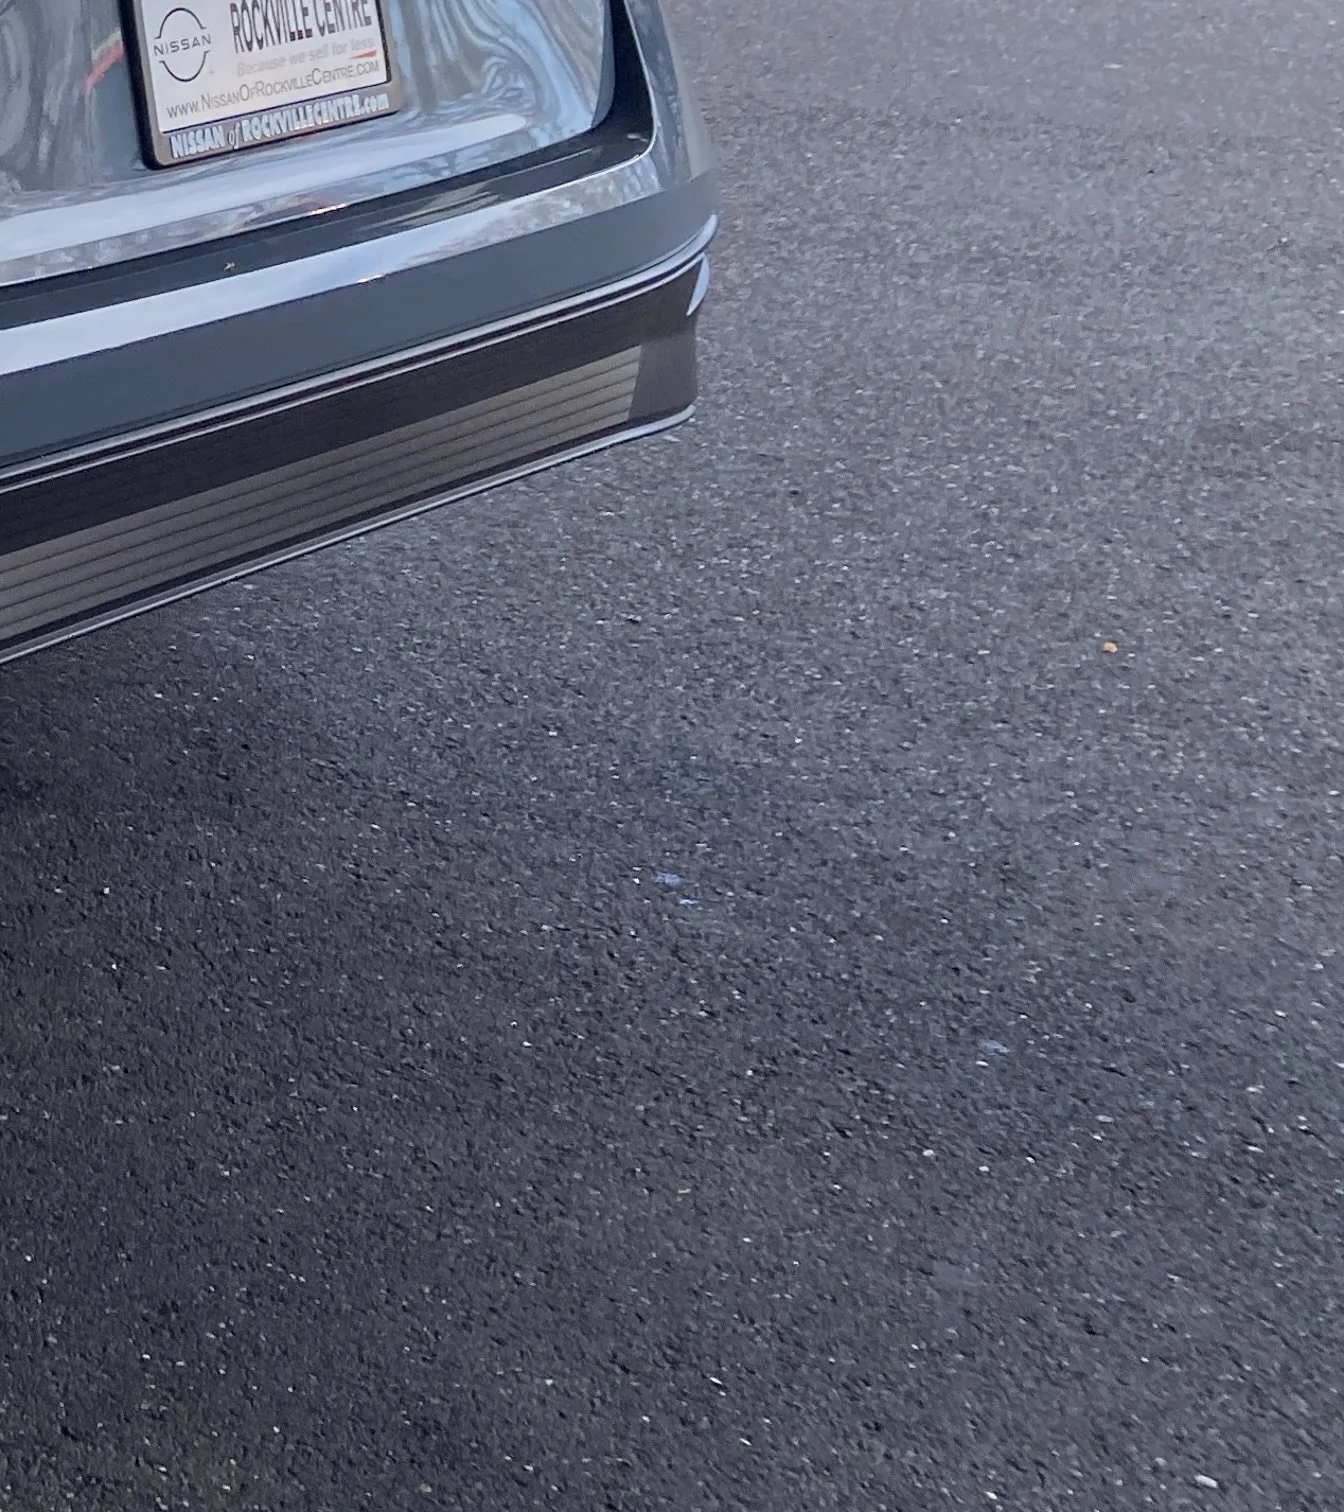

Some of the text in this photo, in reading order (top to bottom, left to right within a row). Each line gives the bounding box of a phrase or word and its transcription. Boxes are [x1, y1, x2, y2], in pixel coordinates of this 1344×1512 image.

[153, 34, 211, 56] NISSAN
[237, 57, 287, 78] Because
[289, 53, 305, 65] we
[308, 43, 330, 59] sell
[171, 125, 225, 159] NISSAN
[227, 123, 241, 149] of
